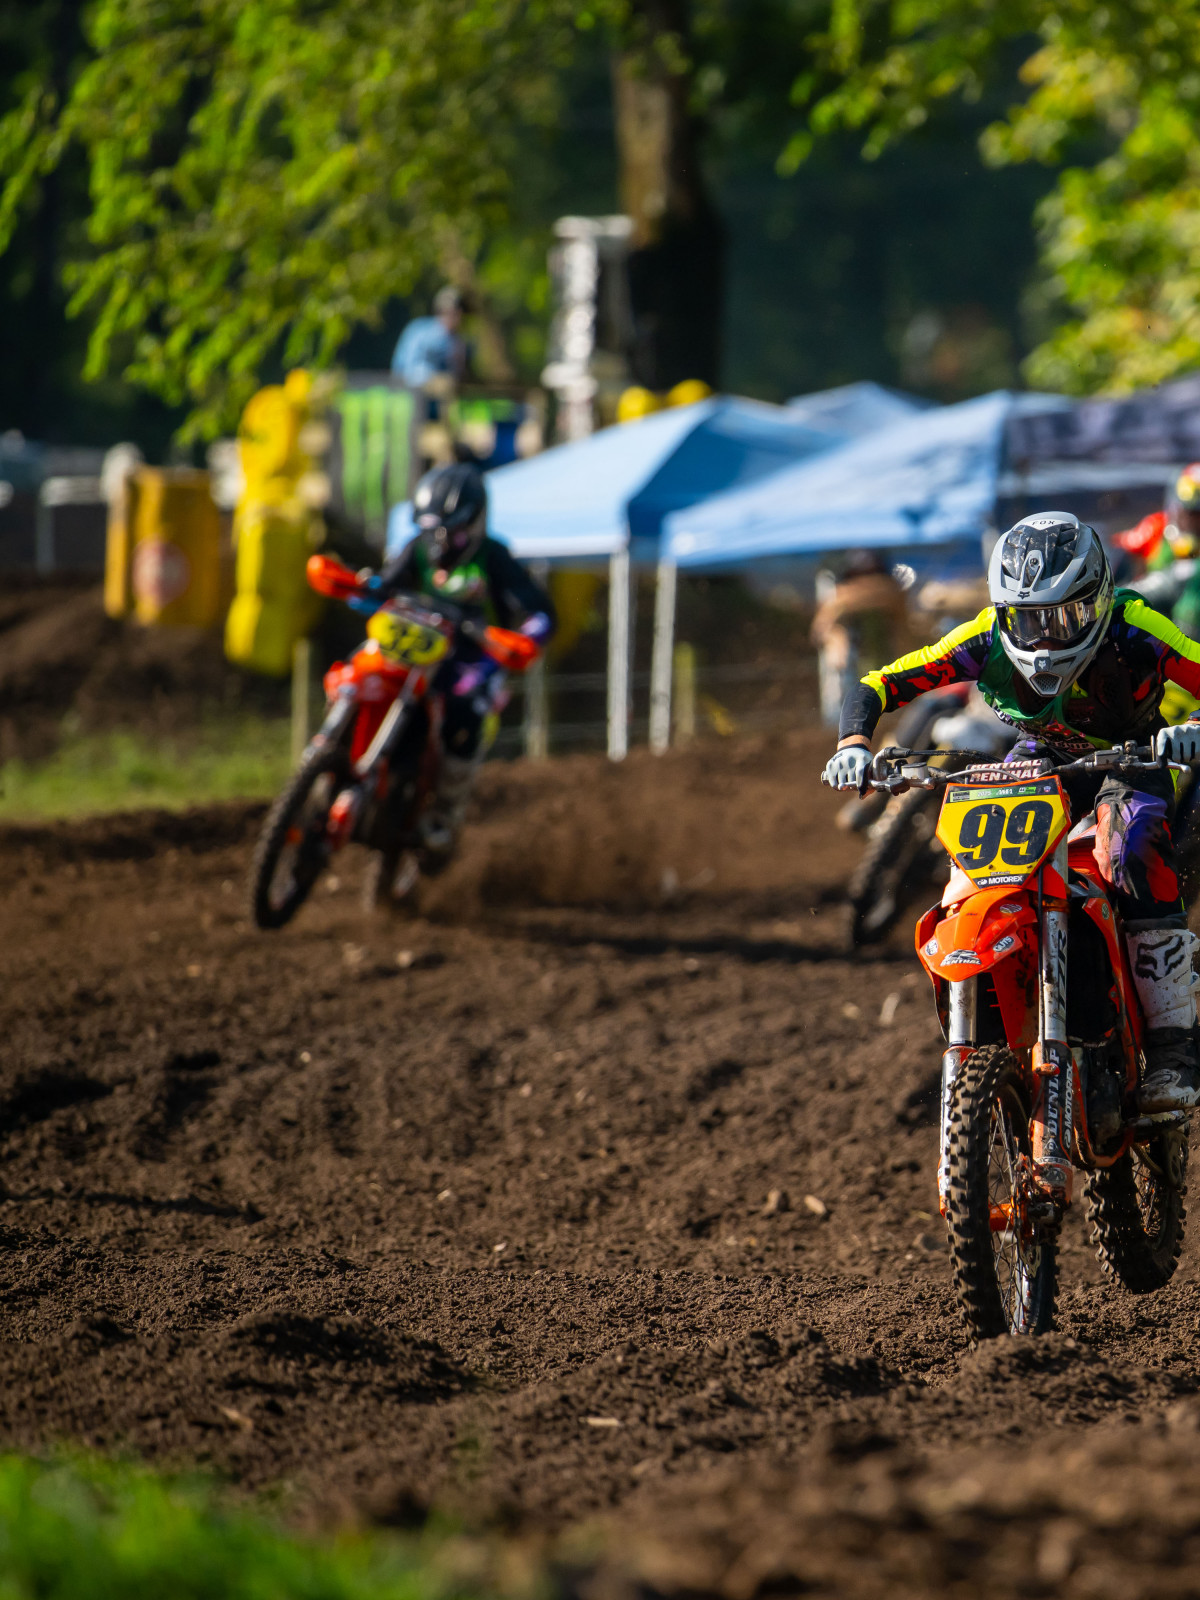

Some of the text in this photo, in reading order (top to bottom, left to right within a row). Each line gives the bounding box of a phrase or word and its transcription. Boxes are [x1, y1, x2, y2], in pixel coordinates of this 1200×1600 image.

[956, 801, 1054, 870] 99
[988, 875, 1023, 885] MOTOREX
[1064, 1061, 1073, 1129] MOTOREX
